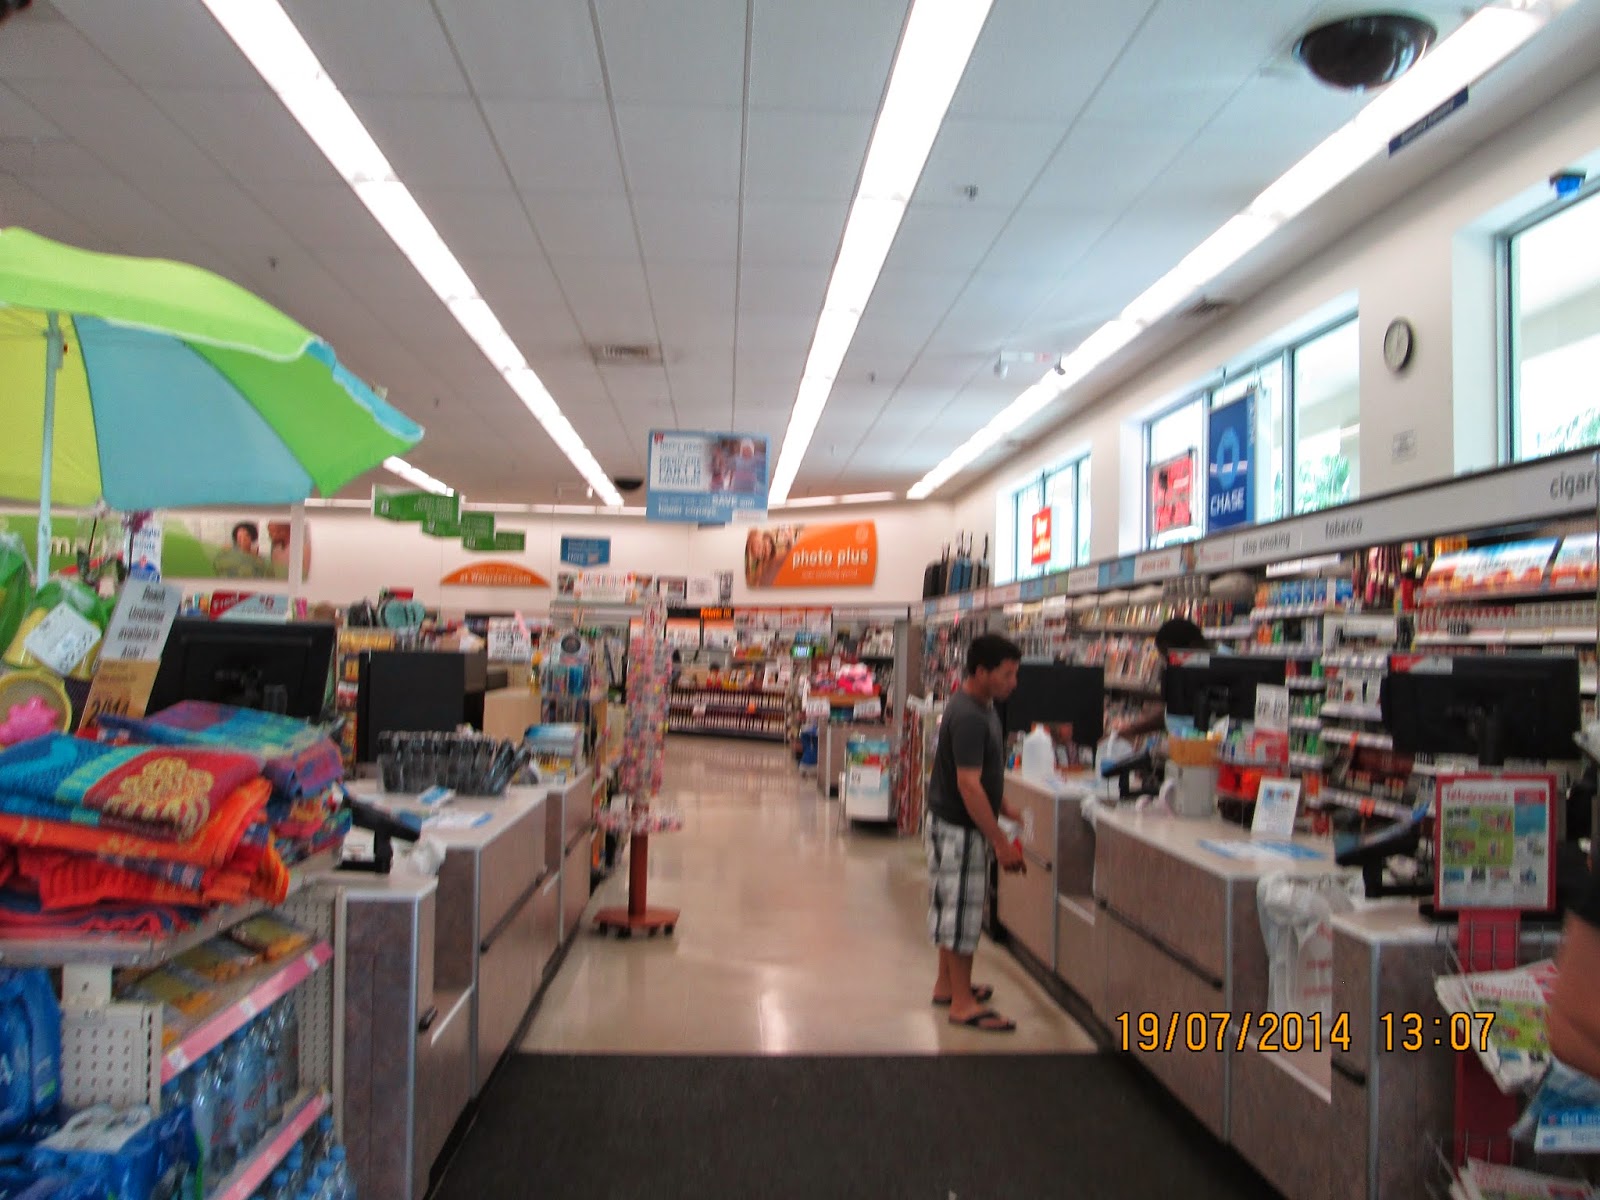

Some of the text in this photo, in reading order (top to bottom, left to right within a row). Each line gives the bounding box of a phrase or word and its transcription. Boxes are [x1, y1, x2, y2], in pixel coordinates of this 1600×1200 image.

[1549, 470, 1597, 501] cigar
[1210, 487, 1244, 516] CHASE
[1325, 519, 1363, 540] tobacco
[792, 546, 869, 571] photo plus
